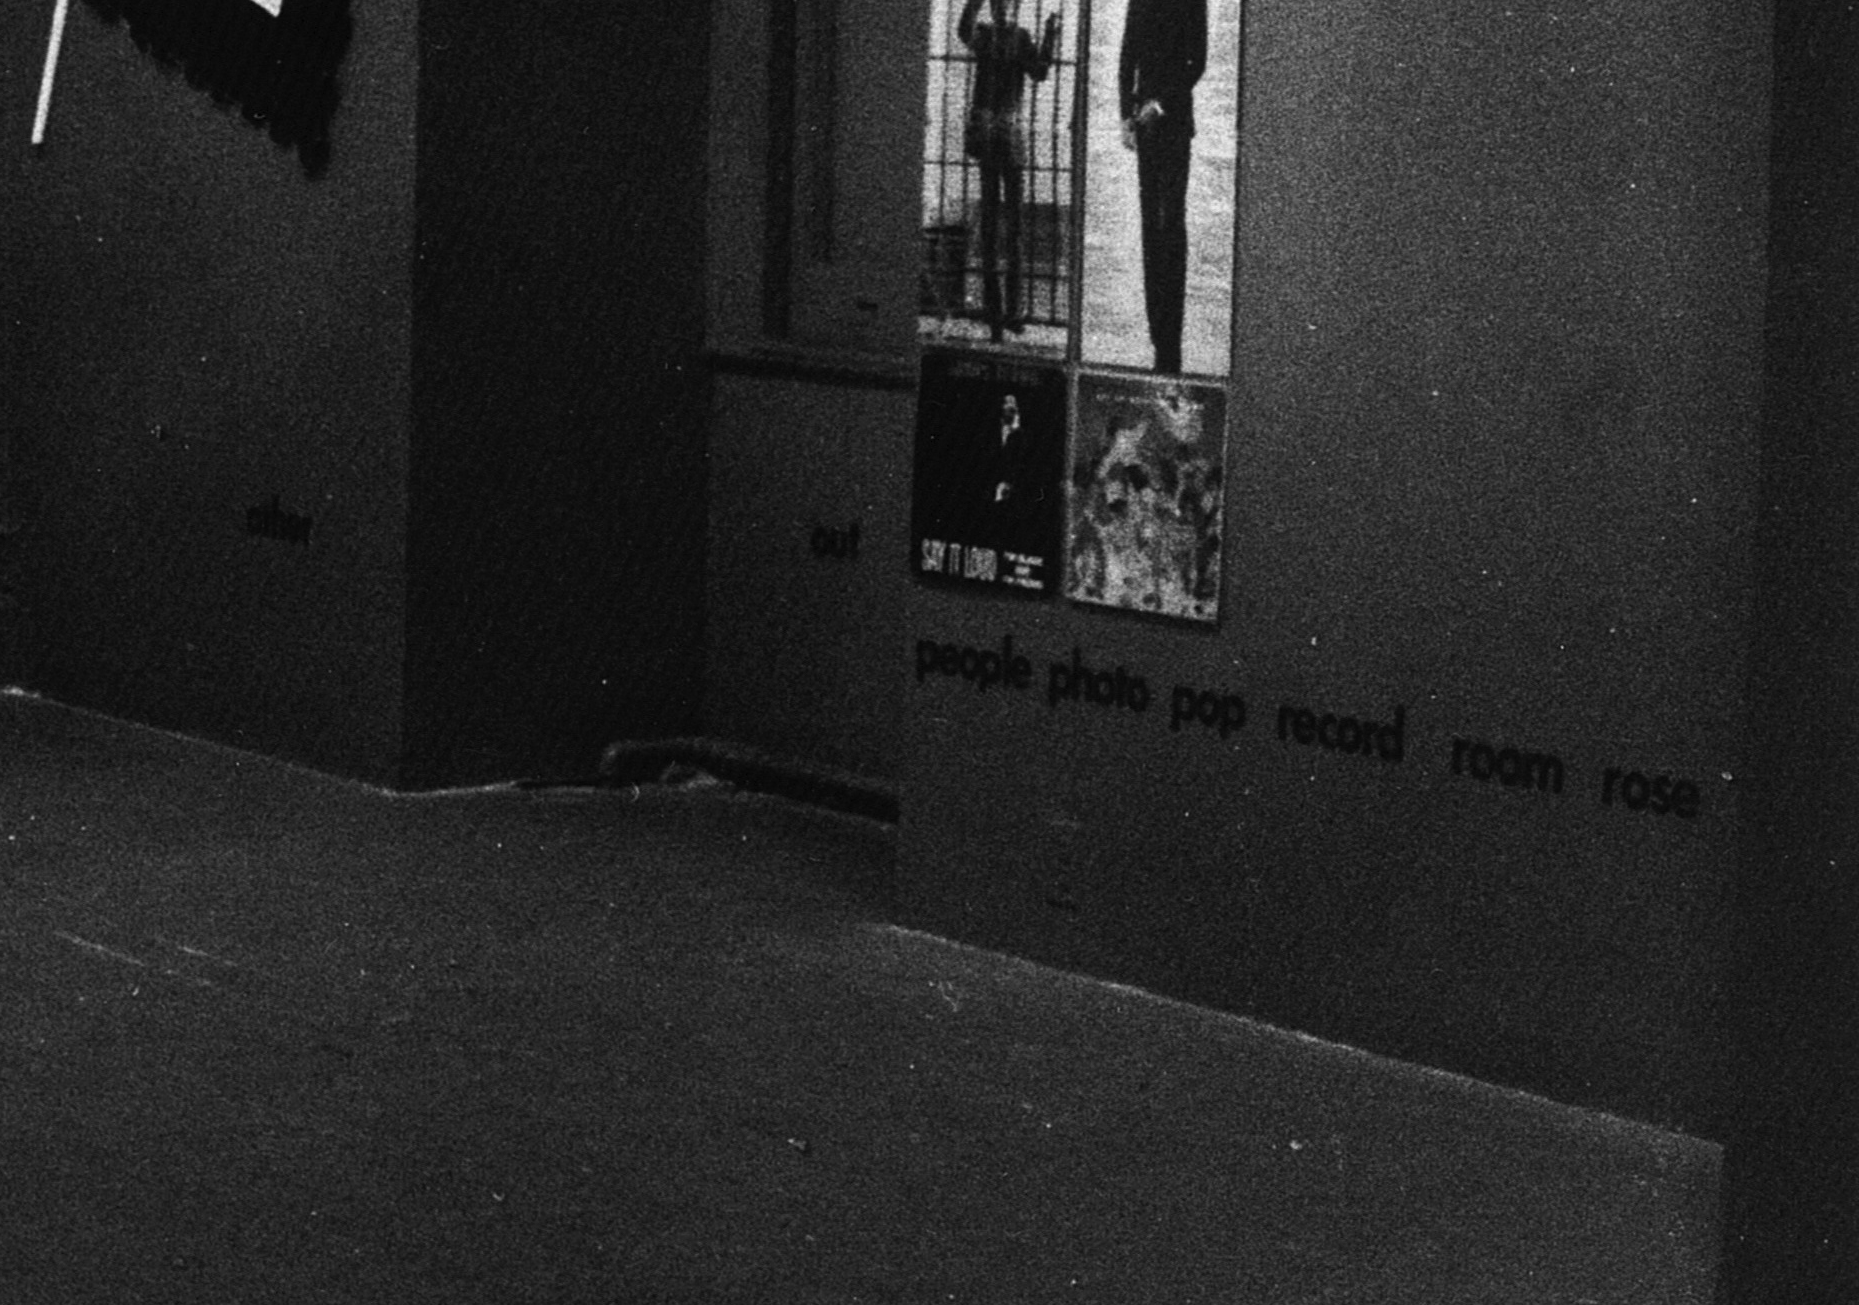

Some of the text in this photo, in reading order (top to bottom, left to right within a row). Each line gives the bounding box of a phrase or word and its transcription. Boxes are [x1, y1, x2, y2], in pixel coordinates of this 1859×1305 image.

[810, 521, 860, 561] out
[921, 537, 946, 572] SAY
[948, 543, 961, 575] IT
[963, 545, 997, 582] LOUD
[915, 634, 1702, 821] people photo pop record room rose
